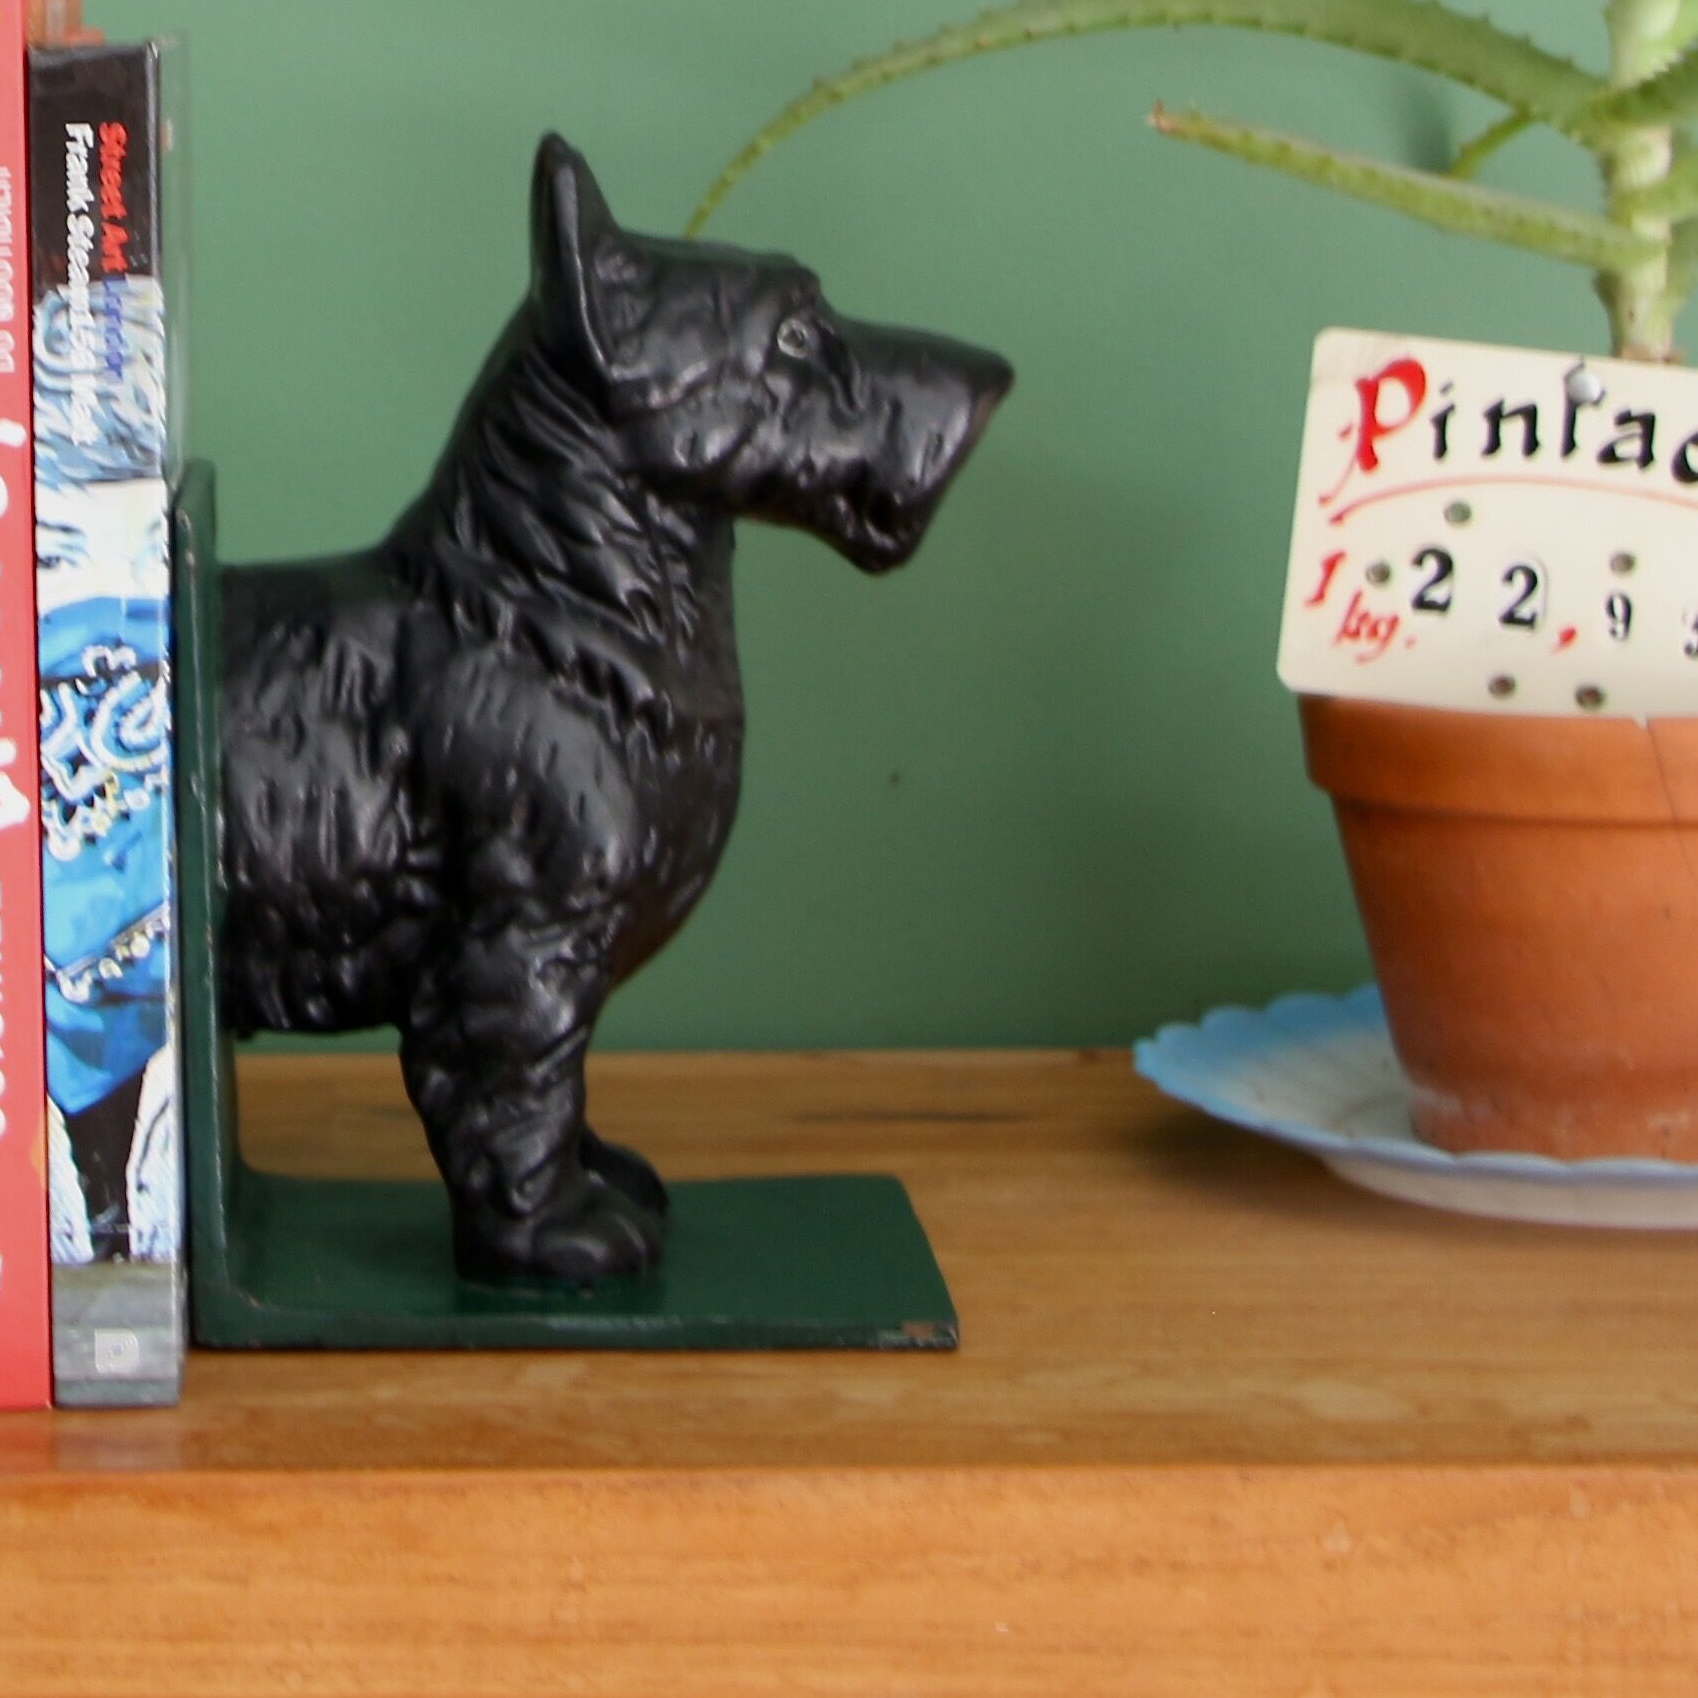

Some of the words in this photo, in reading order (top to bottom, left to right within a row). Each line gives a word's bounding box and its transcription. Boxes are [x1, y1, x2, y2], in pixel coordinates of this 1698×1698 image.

[65, 122, 95, 213] Frank
[98, 121, 128, 219] Street
[101, 221, 129, 272] Art
